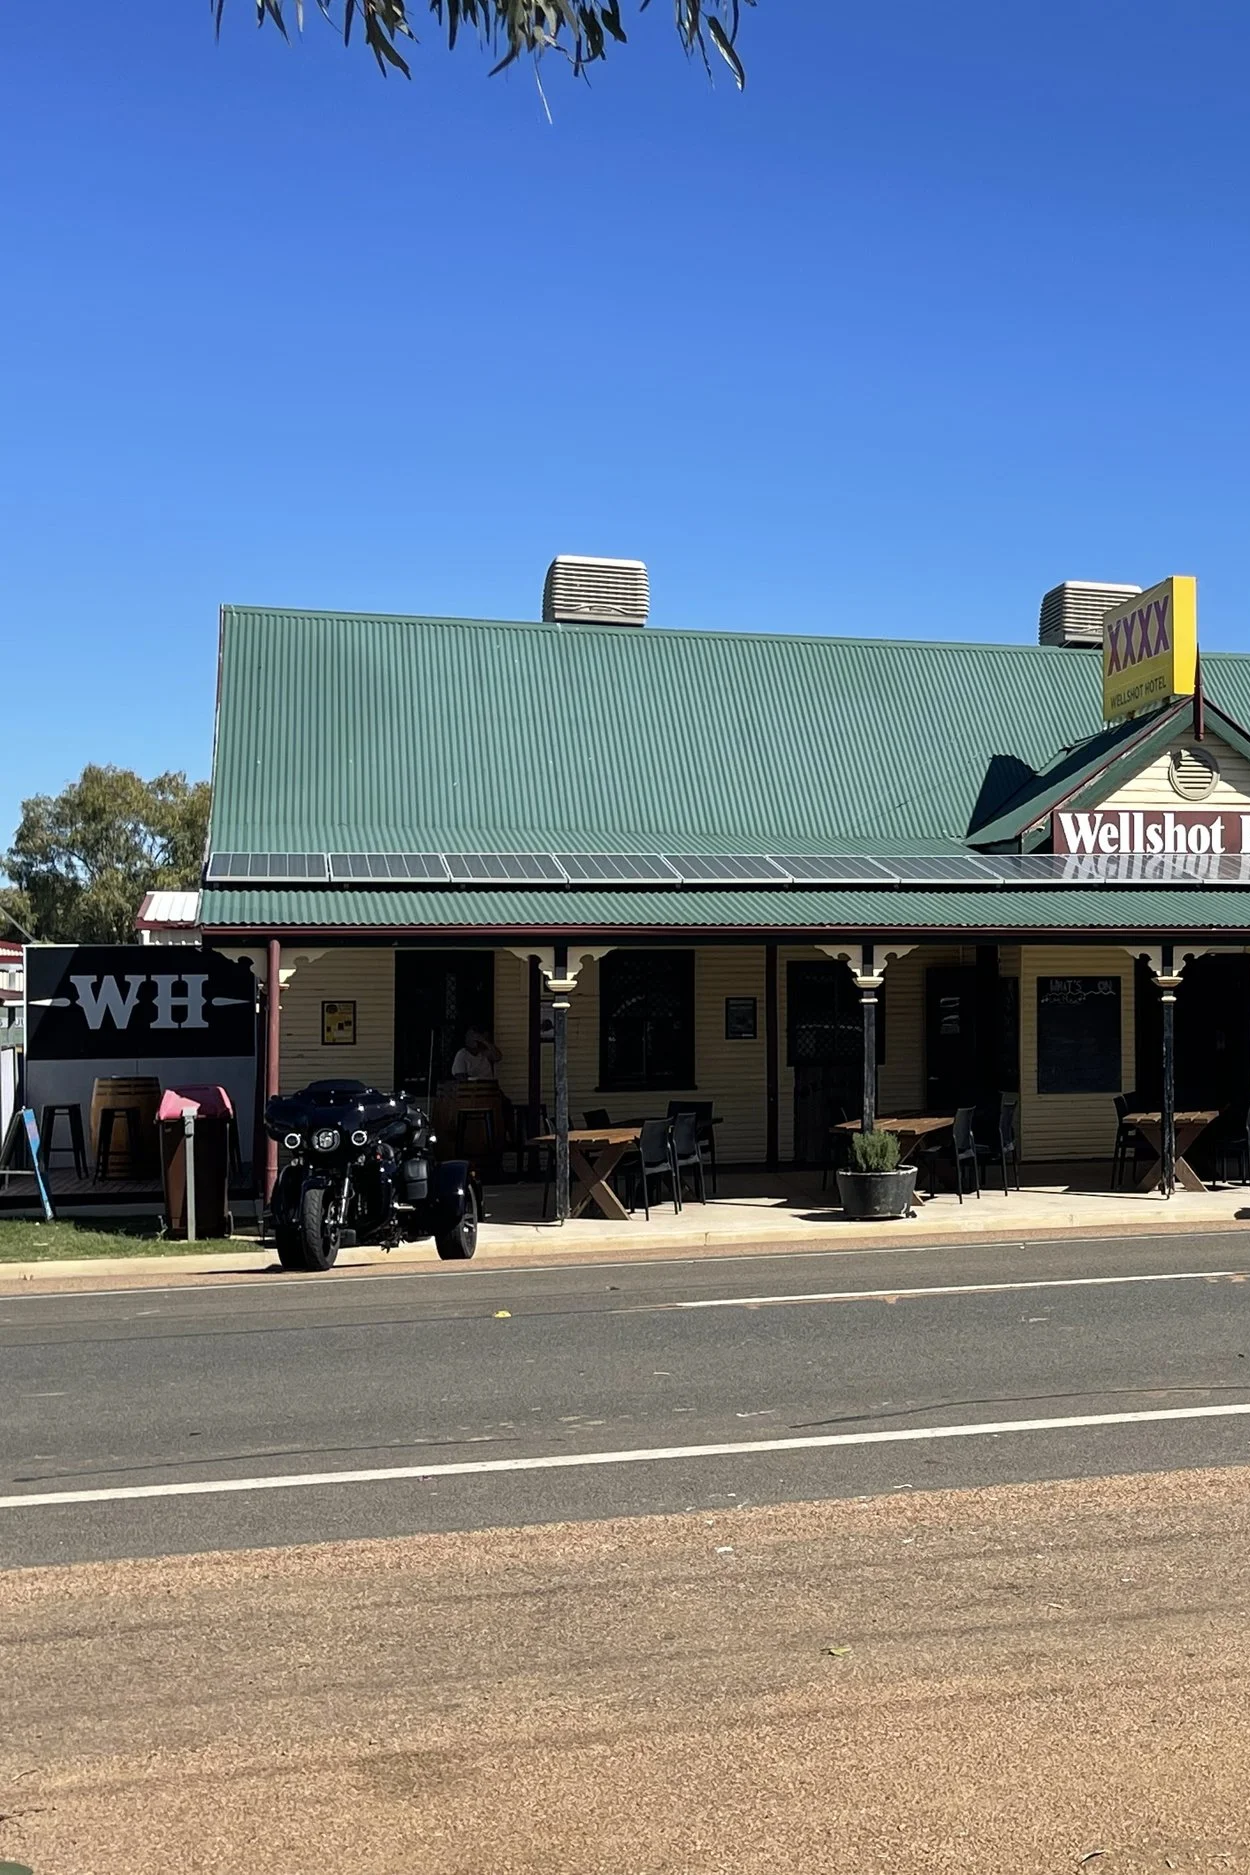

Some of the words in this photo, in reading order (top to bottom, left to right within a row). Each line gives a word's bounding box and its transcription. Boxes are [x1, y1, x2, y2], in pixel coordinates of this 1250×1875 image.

[1108, 595, 1170, 677] XXXX
[1110, 683, 1143, 709] WELLSHOT
[1144, 675, 1167, 694] HOTEL
[1058, 812, 1225, 854] Wellshot
[70, 974, 209, 1029] WH
[1050, 980, 1083, 993] WHAT'S
